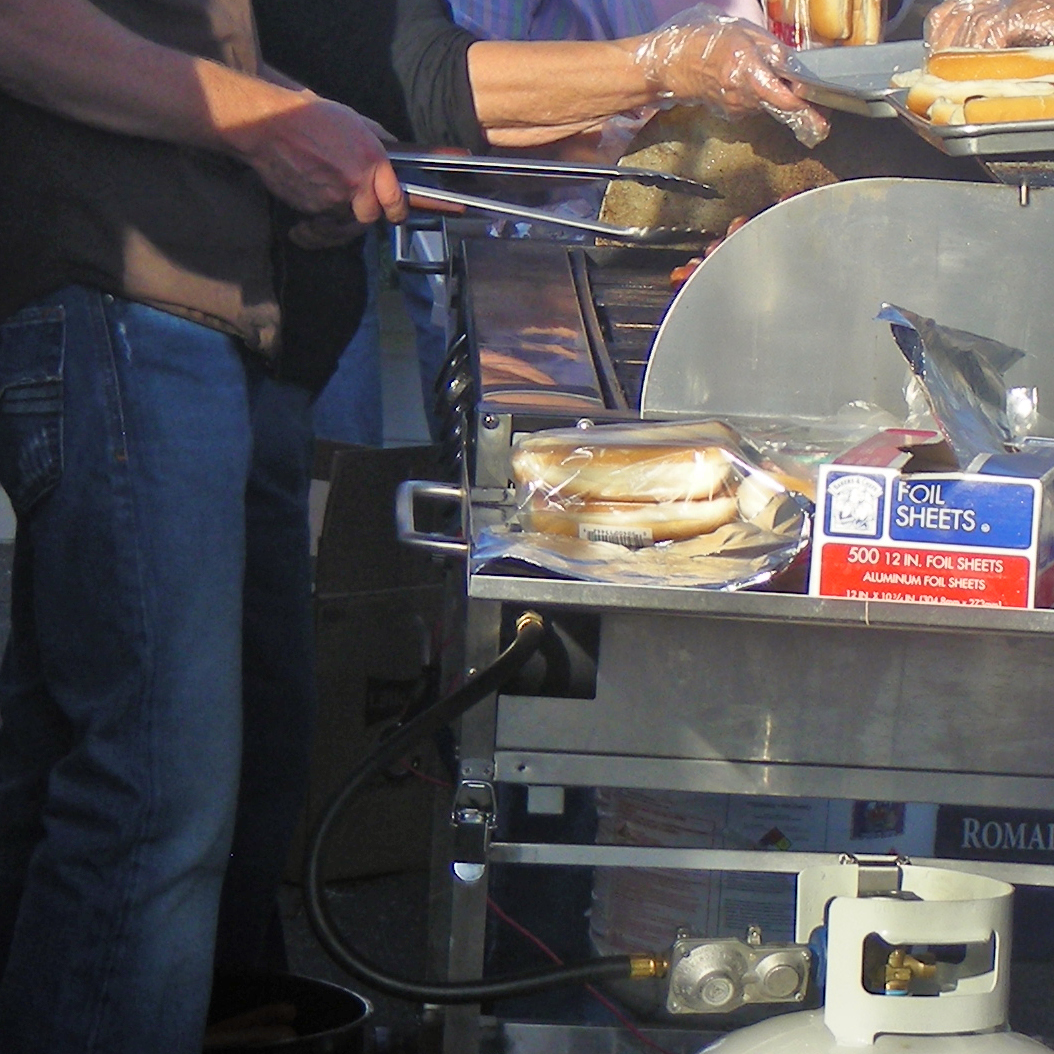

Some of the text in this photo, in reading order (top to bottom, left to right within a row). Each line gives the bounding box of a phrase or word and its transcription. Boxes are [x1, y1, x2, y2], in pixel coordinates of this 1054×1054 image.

[896, 481, 945, 506] FOIL
[896, 505, 976, 532] SHEETS
[847, 546, 1004, 574] 500 12 IN. FOIL SHEETS
[862, 571, 986, 591] ALUMINUM FOIL SHEETS
